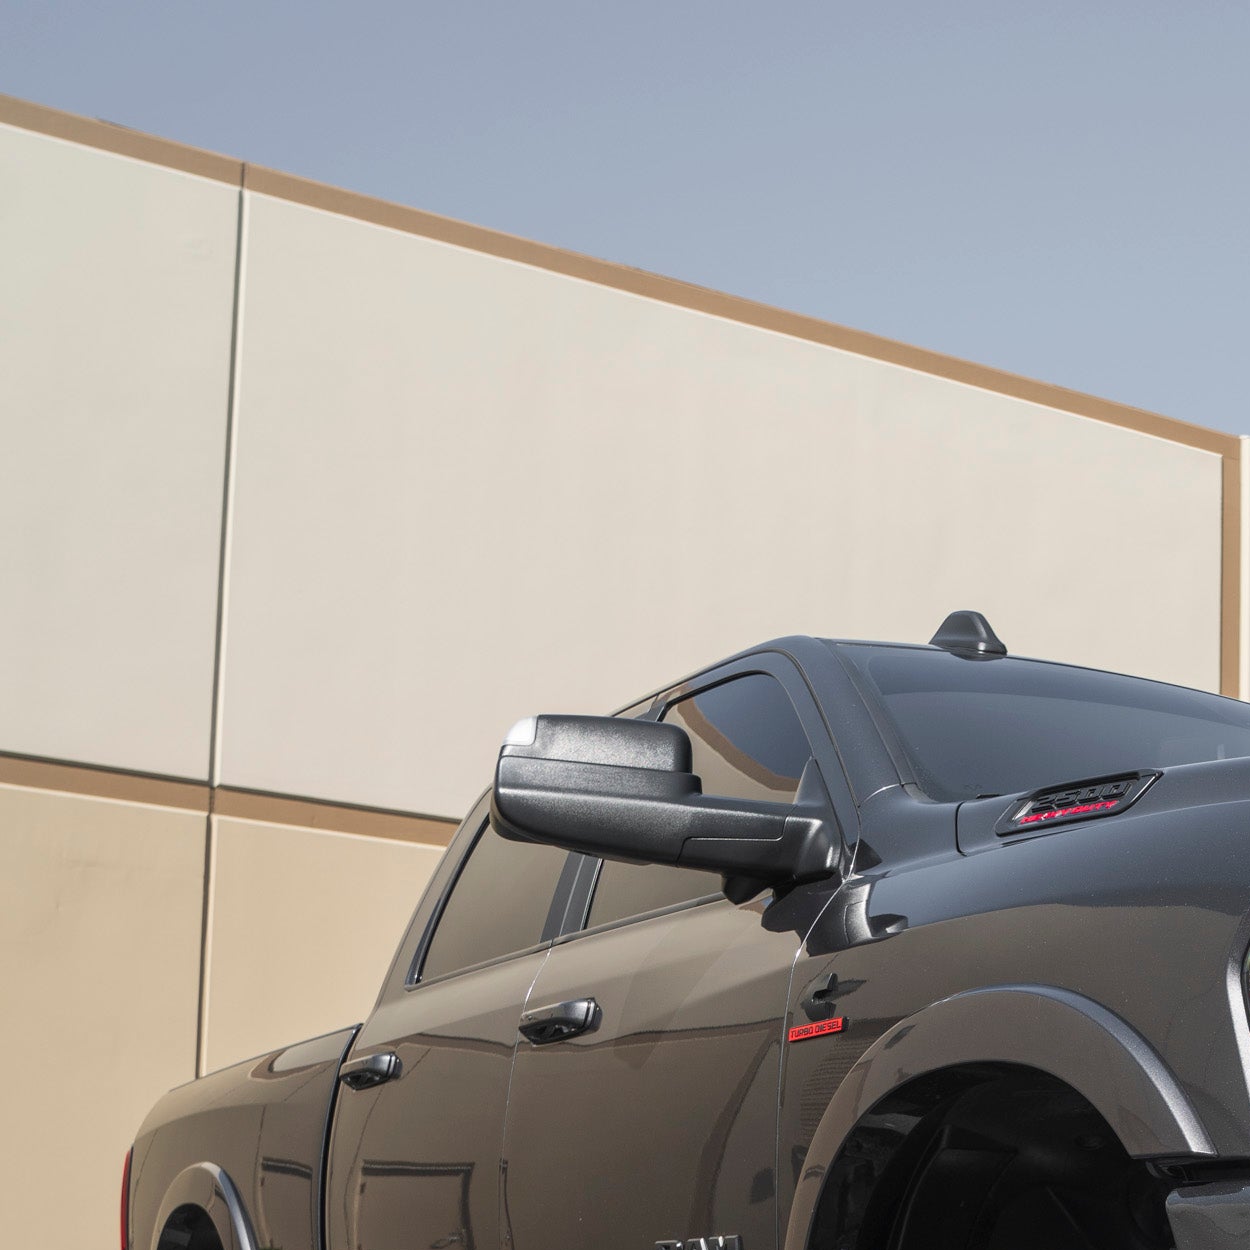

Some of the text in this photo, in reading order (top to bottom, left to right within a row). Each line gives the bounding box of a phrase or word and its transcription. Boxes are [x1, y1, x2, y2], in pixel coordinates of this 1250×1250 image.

[1070, 799, 1119, 814] DUTY
[790, 1020, 841, 1039] TURBO DIESEL
